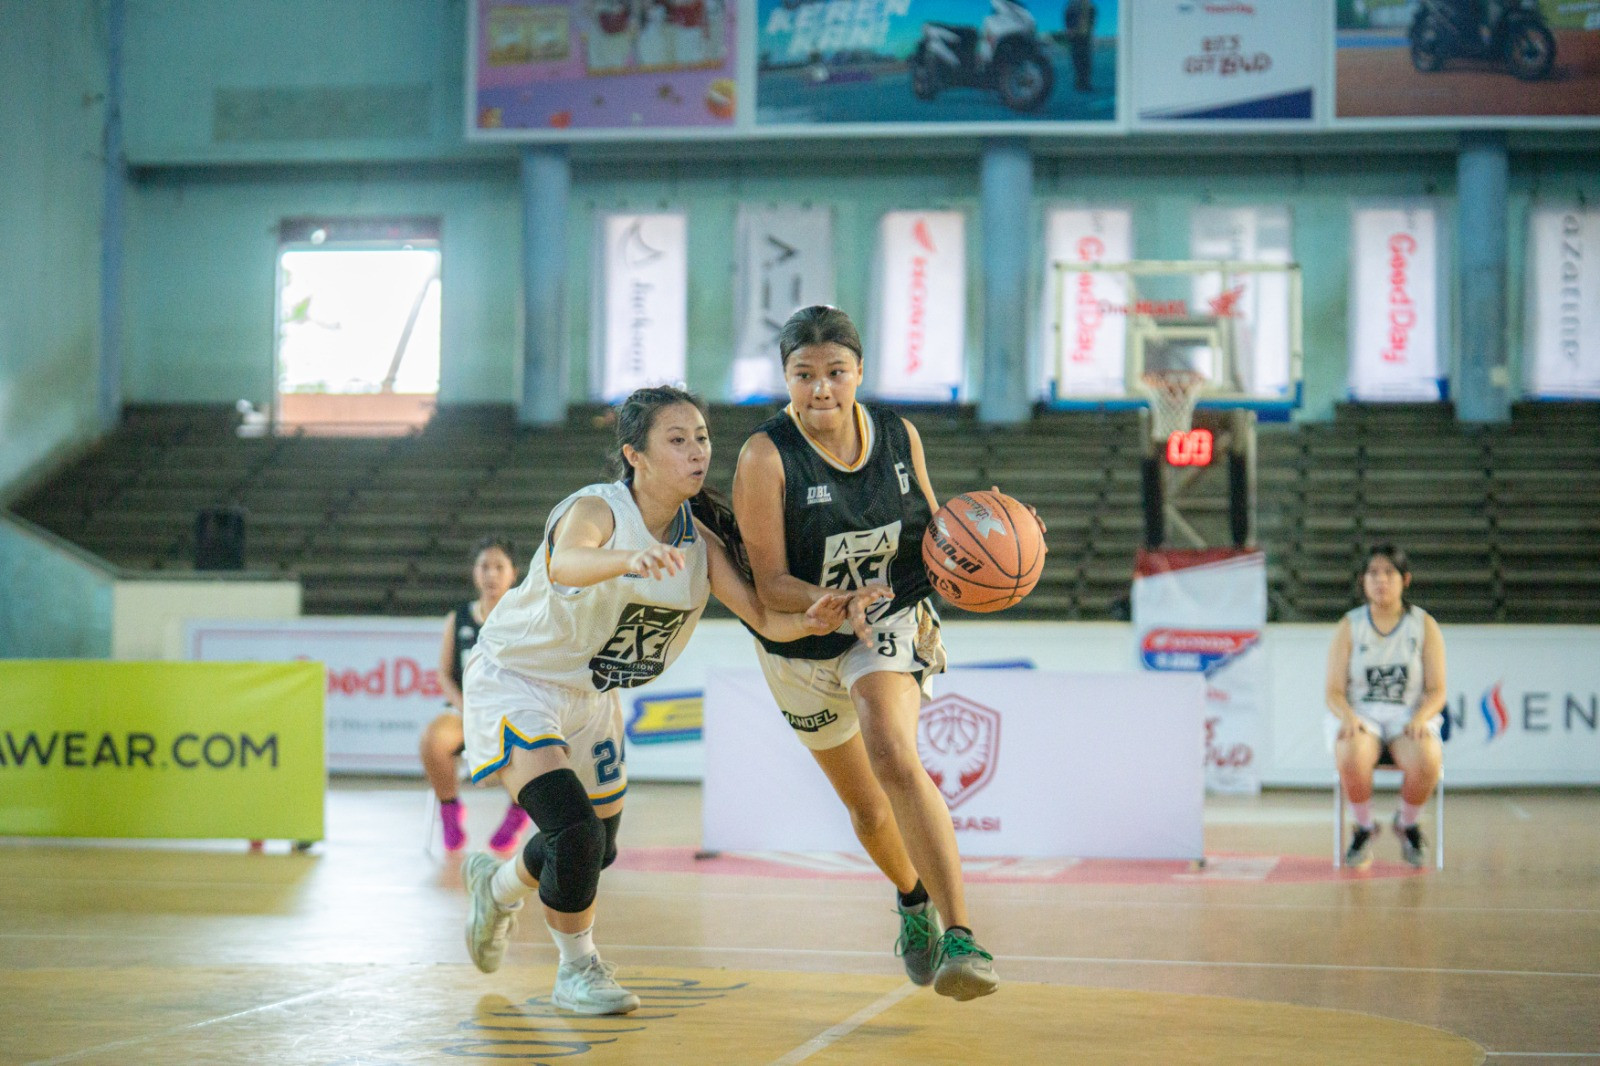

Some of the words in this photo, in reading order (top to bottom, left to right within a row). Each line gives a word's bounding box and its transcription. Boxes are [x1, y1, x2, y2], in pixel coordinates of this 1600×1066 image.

[1388, 232, 1417, 306] Good
[1380, 307, 1417, 364] Day
[808, 485, 830, 500] DBL
[877, 632, 897, 658] 5
[327, 657, 388, 696] ood
[393, 656, 443, 696] Da
[591, 738, 625, 786] 2
